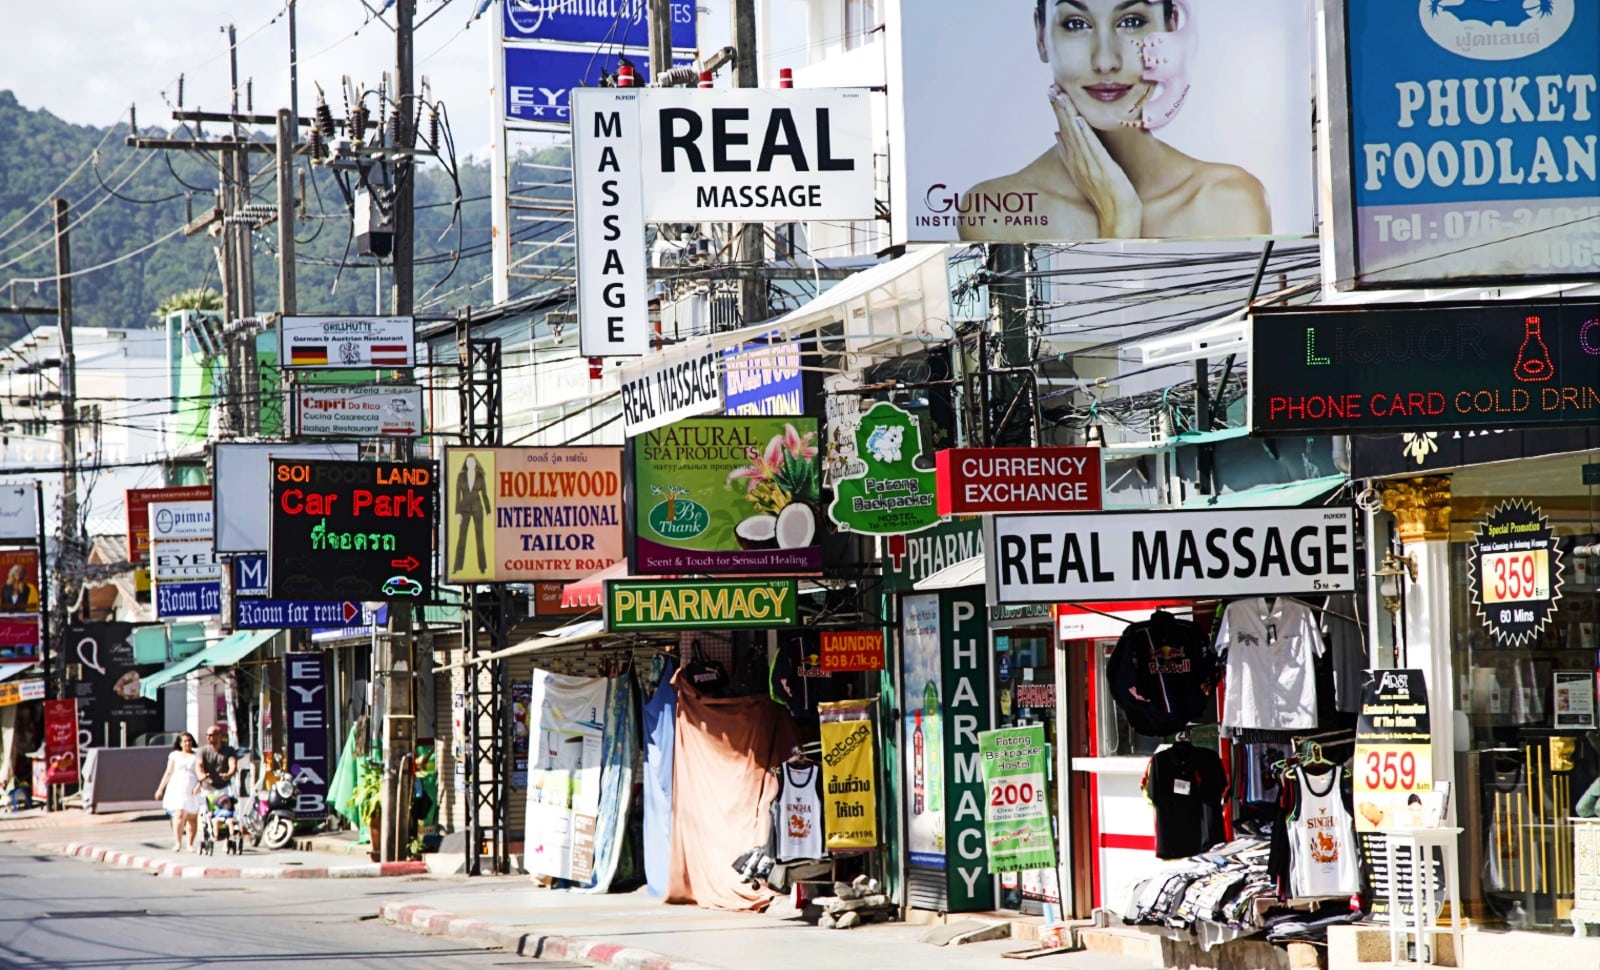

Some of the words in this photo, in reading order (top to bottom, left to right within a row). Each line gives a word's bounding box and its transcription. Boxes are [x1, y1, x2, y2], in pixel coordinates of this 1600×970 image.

[1395, 74, 1597, 128] PHUKET
[659, 107, 855, 173] REAL
[696, 184, 822, 208] MASSAGE
[924, 183, 1038, 213] GUINOT
[594, 111, 625, 343] MASSAGE
[916, 215, 986, 227] INSTITUT
[1005, 215, 1049, 226] PARIS
[622, 376, 656, 427] REAL
[656, 352, 717, 415] MASSAGE
[303, 396, 347, 412] Capri
[1270, 394, 1362, 420] PHONE
[1369, 391, 1446, 417] CARD
[1454, 388, 1530, 414] COLD
[644, 426, 757, 447] NATURAL
[643, 446, 672, 461] SPA
[675, 445, 759, 461] PRODUCTS
[277, 464, 310, 484] SOI
[376, 466, 430, 486] LAND
[962, 456, 1087, 478] CURRENCY
[499, 470, 618, 498] HOLLYWOOD
[864, 477, 920, 494] Patong
[965, 482, 1088, 503] EXCHANGE
[281, 488, 338, 515] Car
[353, 488, 425, 518] Park
[675, 501, 702, 521] Be
[852, 493, 935, 514] Backpacker
[497, 504, 619, 529] INTERNATIONAL
[659, 520, 701, 534] Thank
[1487, 523, 1510, 537] Special
[1511, 520, 1541, 534] Promotion
[311, 518, 396, 551] ที่จอดรถ
[520, 533, 595, 552] TAILOR
[504, 558, 572, 571] COUNTRY
[646, 557, 673, 568] Scent
[673, 557, 683, 567] &
[686, 556, 714, 567] Touch
[716, 555, 730, 566] for
[731, 555, 768, 566] Sensual
[770, 553, 808, 568] Healing
[1000, 531, 1114, 586] REAL
[1131, 524, 1350, 582] MASSAGE
[1494, 554, 1535, 600] 359
[159, 588, 198, 615] Room
[615, 587, 789, 622] PHARMACY
[238, 603, 284, 626] Room
[287, 602, 309, 624] for
[313, 602, 342, 624] rent
[1500, 609, 1511, 624] 60
[1513, 608, 1535, 623] Mins
[823, 634, 882, 653] LAUNDRY
[289, 661, 326, 813] EYELAB
[951, 600, 984, 898] PHARMACY
[1365, 751, 1416, 791] 359
[991, 782, 1034, 807] 200
